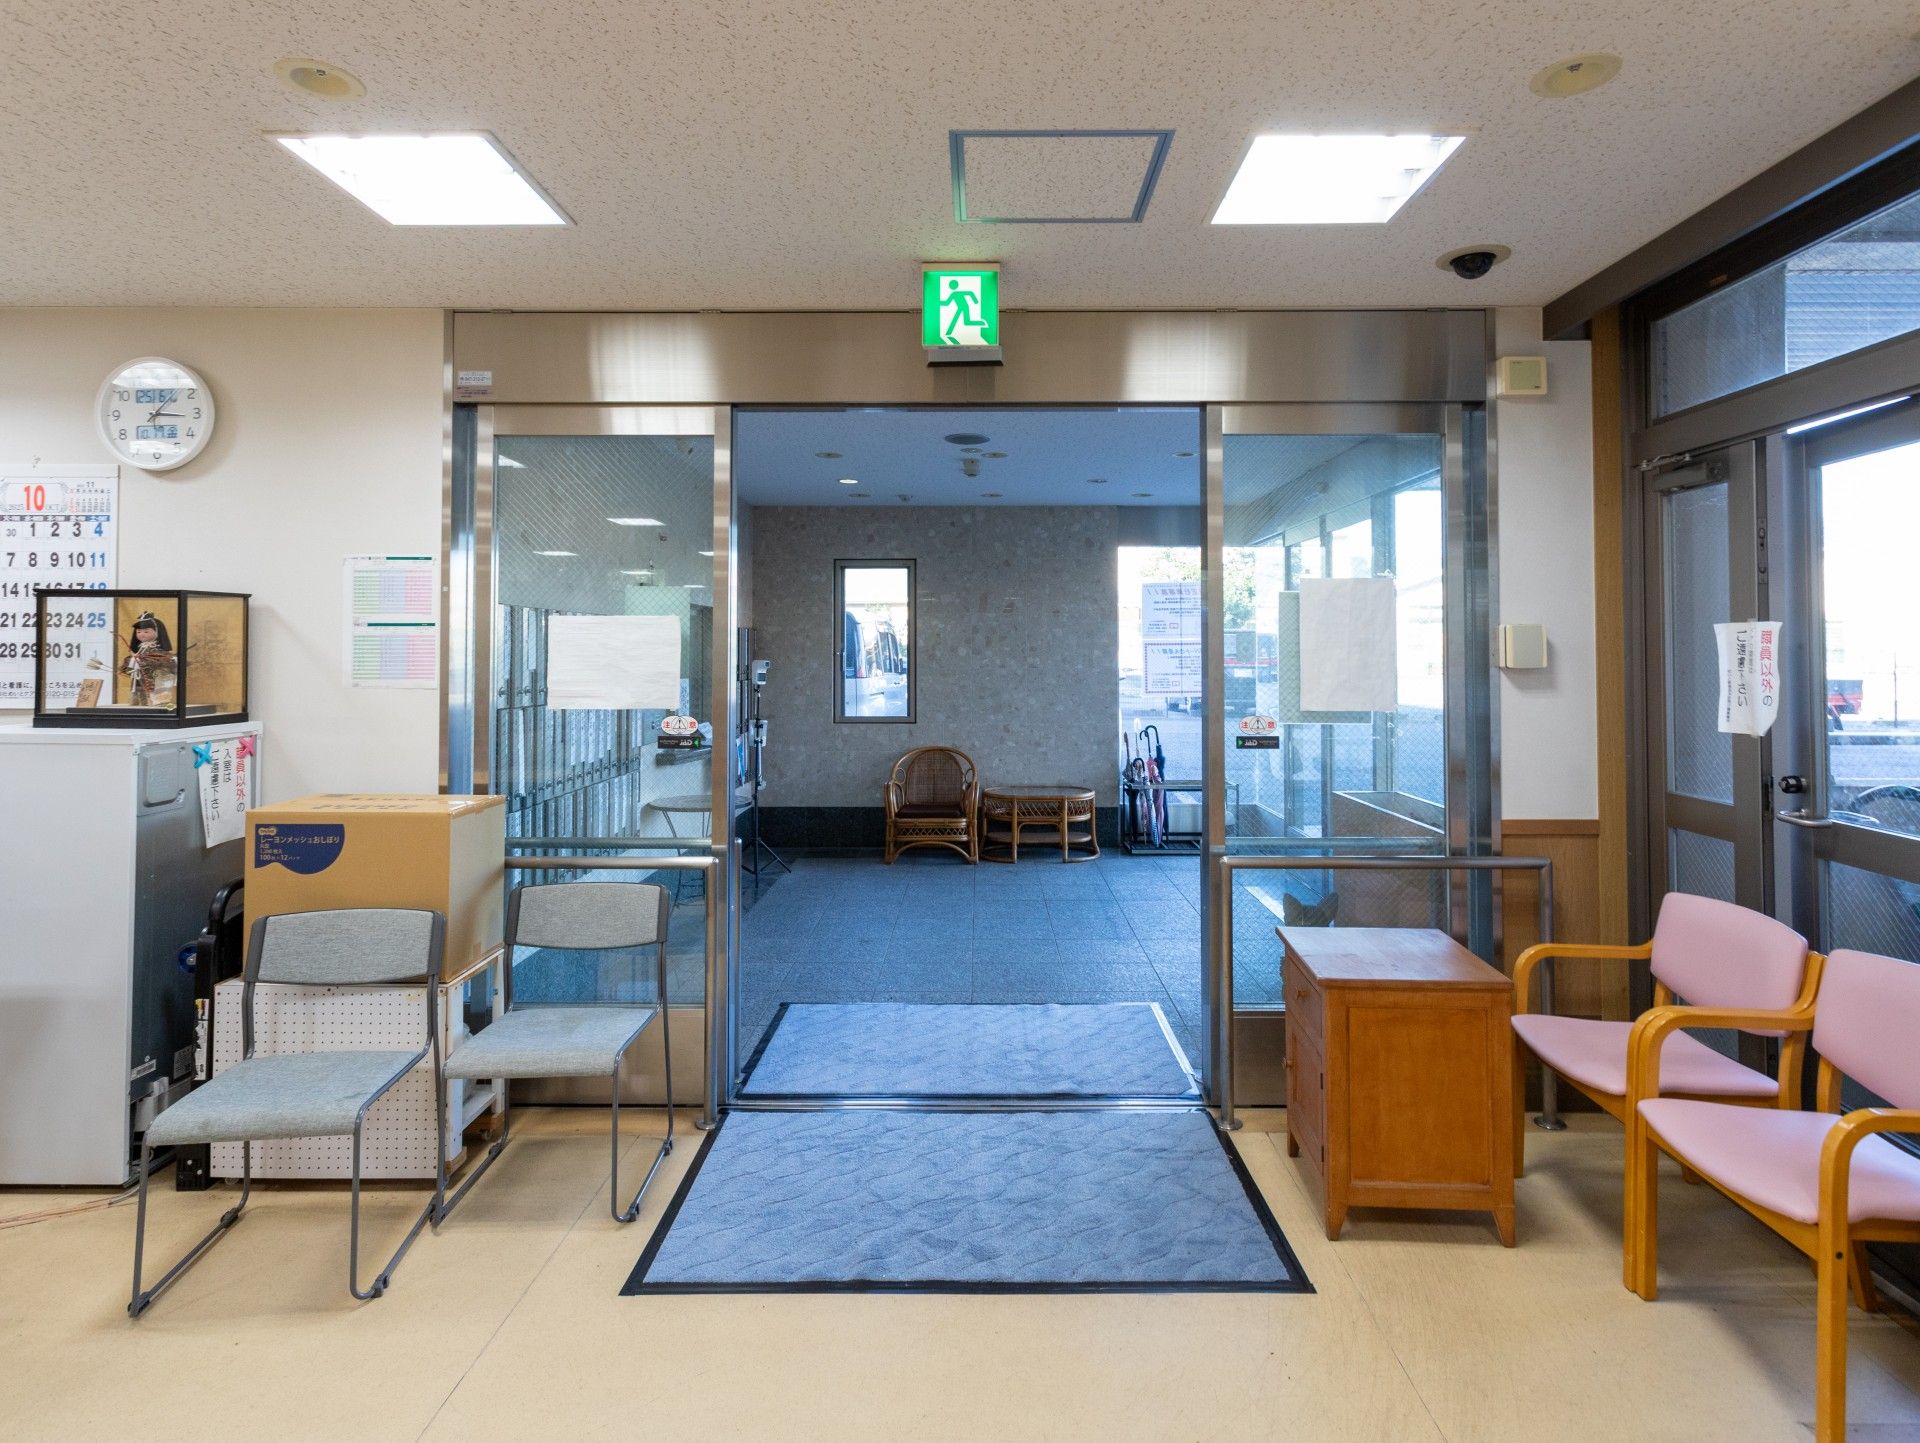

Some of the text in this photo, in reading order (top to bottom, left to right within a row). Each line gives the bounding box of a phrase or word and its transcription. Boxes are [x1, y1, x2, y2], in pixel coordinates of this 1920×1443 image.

[118, 390, 130, 402] 10
[187, 388, 196, 400] 2
[112, 410, 120, 422] 9
[193, 408, 201, 419] 3
[118, 428, 127, 440] 8
[186, 427, 195, 439] 4
[24, 484, 45, 511] 10
[6, 522, 103, 537] 30 1 2 3 4
[6, 552, 105, 567] 7 8 9 10 11
[2, 583, 19, 597] 14
[0, 612, 16, 628] 21
[22, 612, 37, 628] 22
[66, 612, 84, 628] 24
[87, 612, 106, 628] 25
[0, 643, 17, 658] 28
[21, 643, 37, 658] 29
[65, 643, 80, 658] 31
[1760, 630, 1774, 706] 職員以外の
[260, 836, 340, 844] レーヨンメッシュおしぼり
